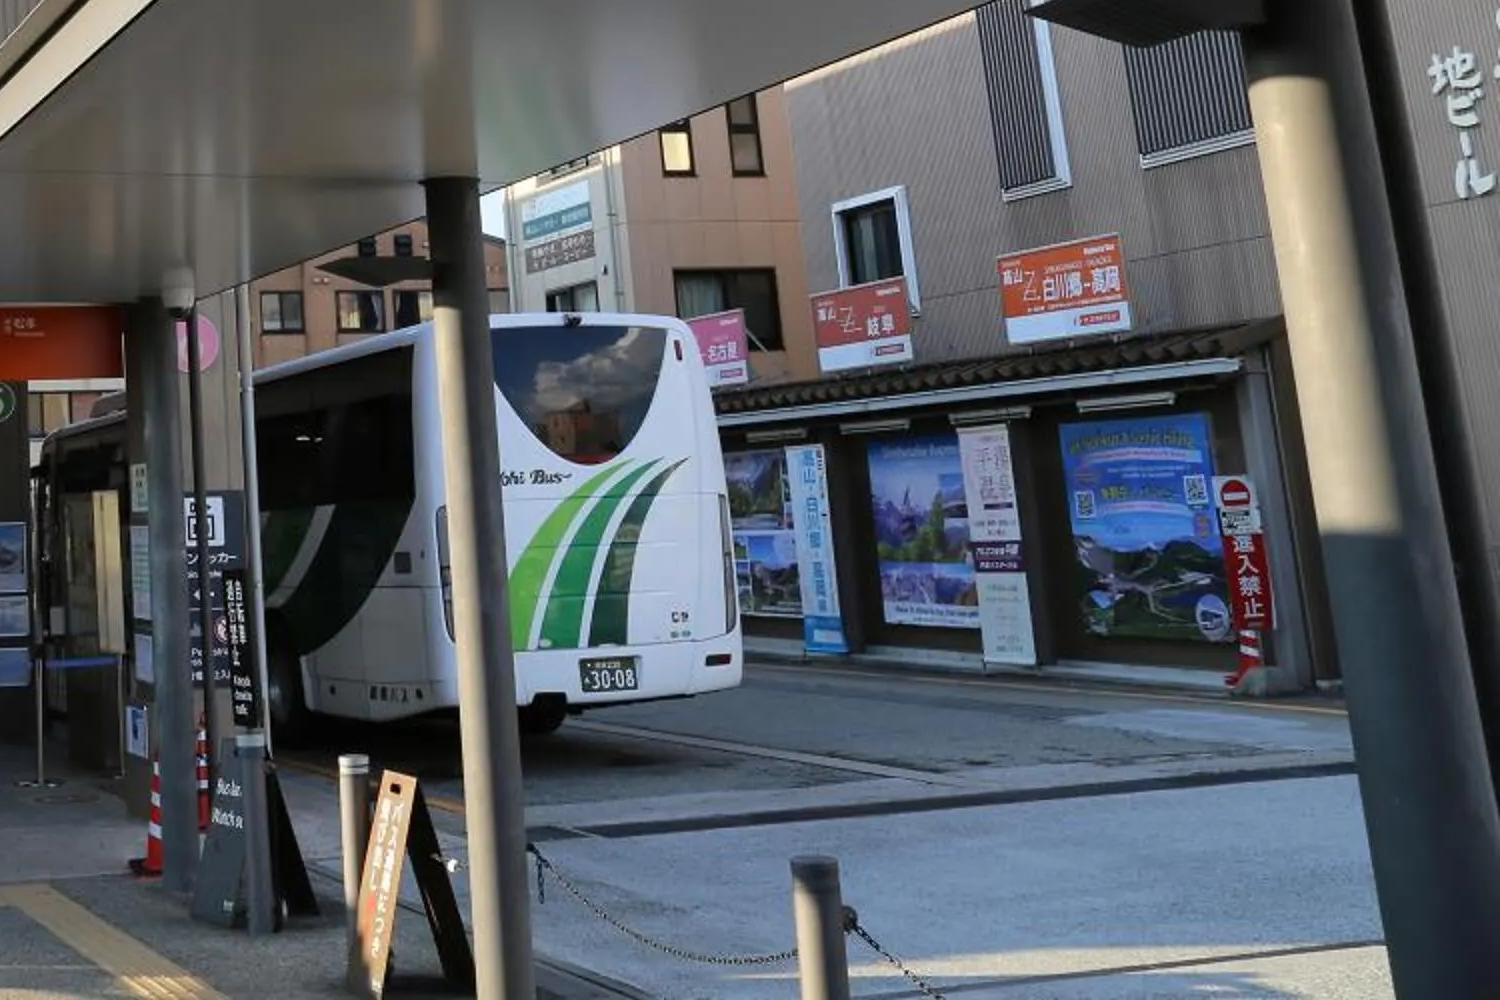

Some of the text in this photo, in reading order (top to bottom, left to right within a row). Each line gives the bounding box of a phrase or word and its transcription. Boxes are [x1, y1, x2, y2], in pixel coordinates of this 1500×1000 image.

[1427, 46, 1497, 201] 地ビール
[500, 468, 567, 487] ohi Bus
[1233, 535, 1265, 620] 進入禁止
